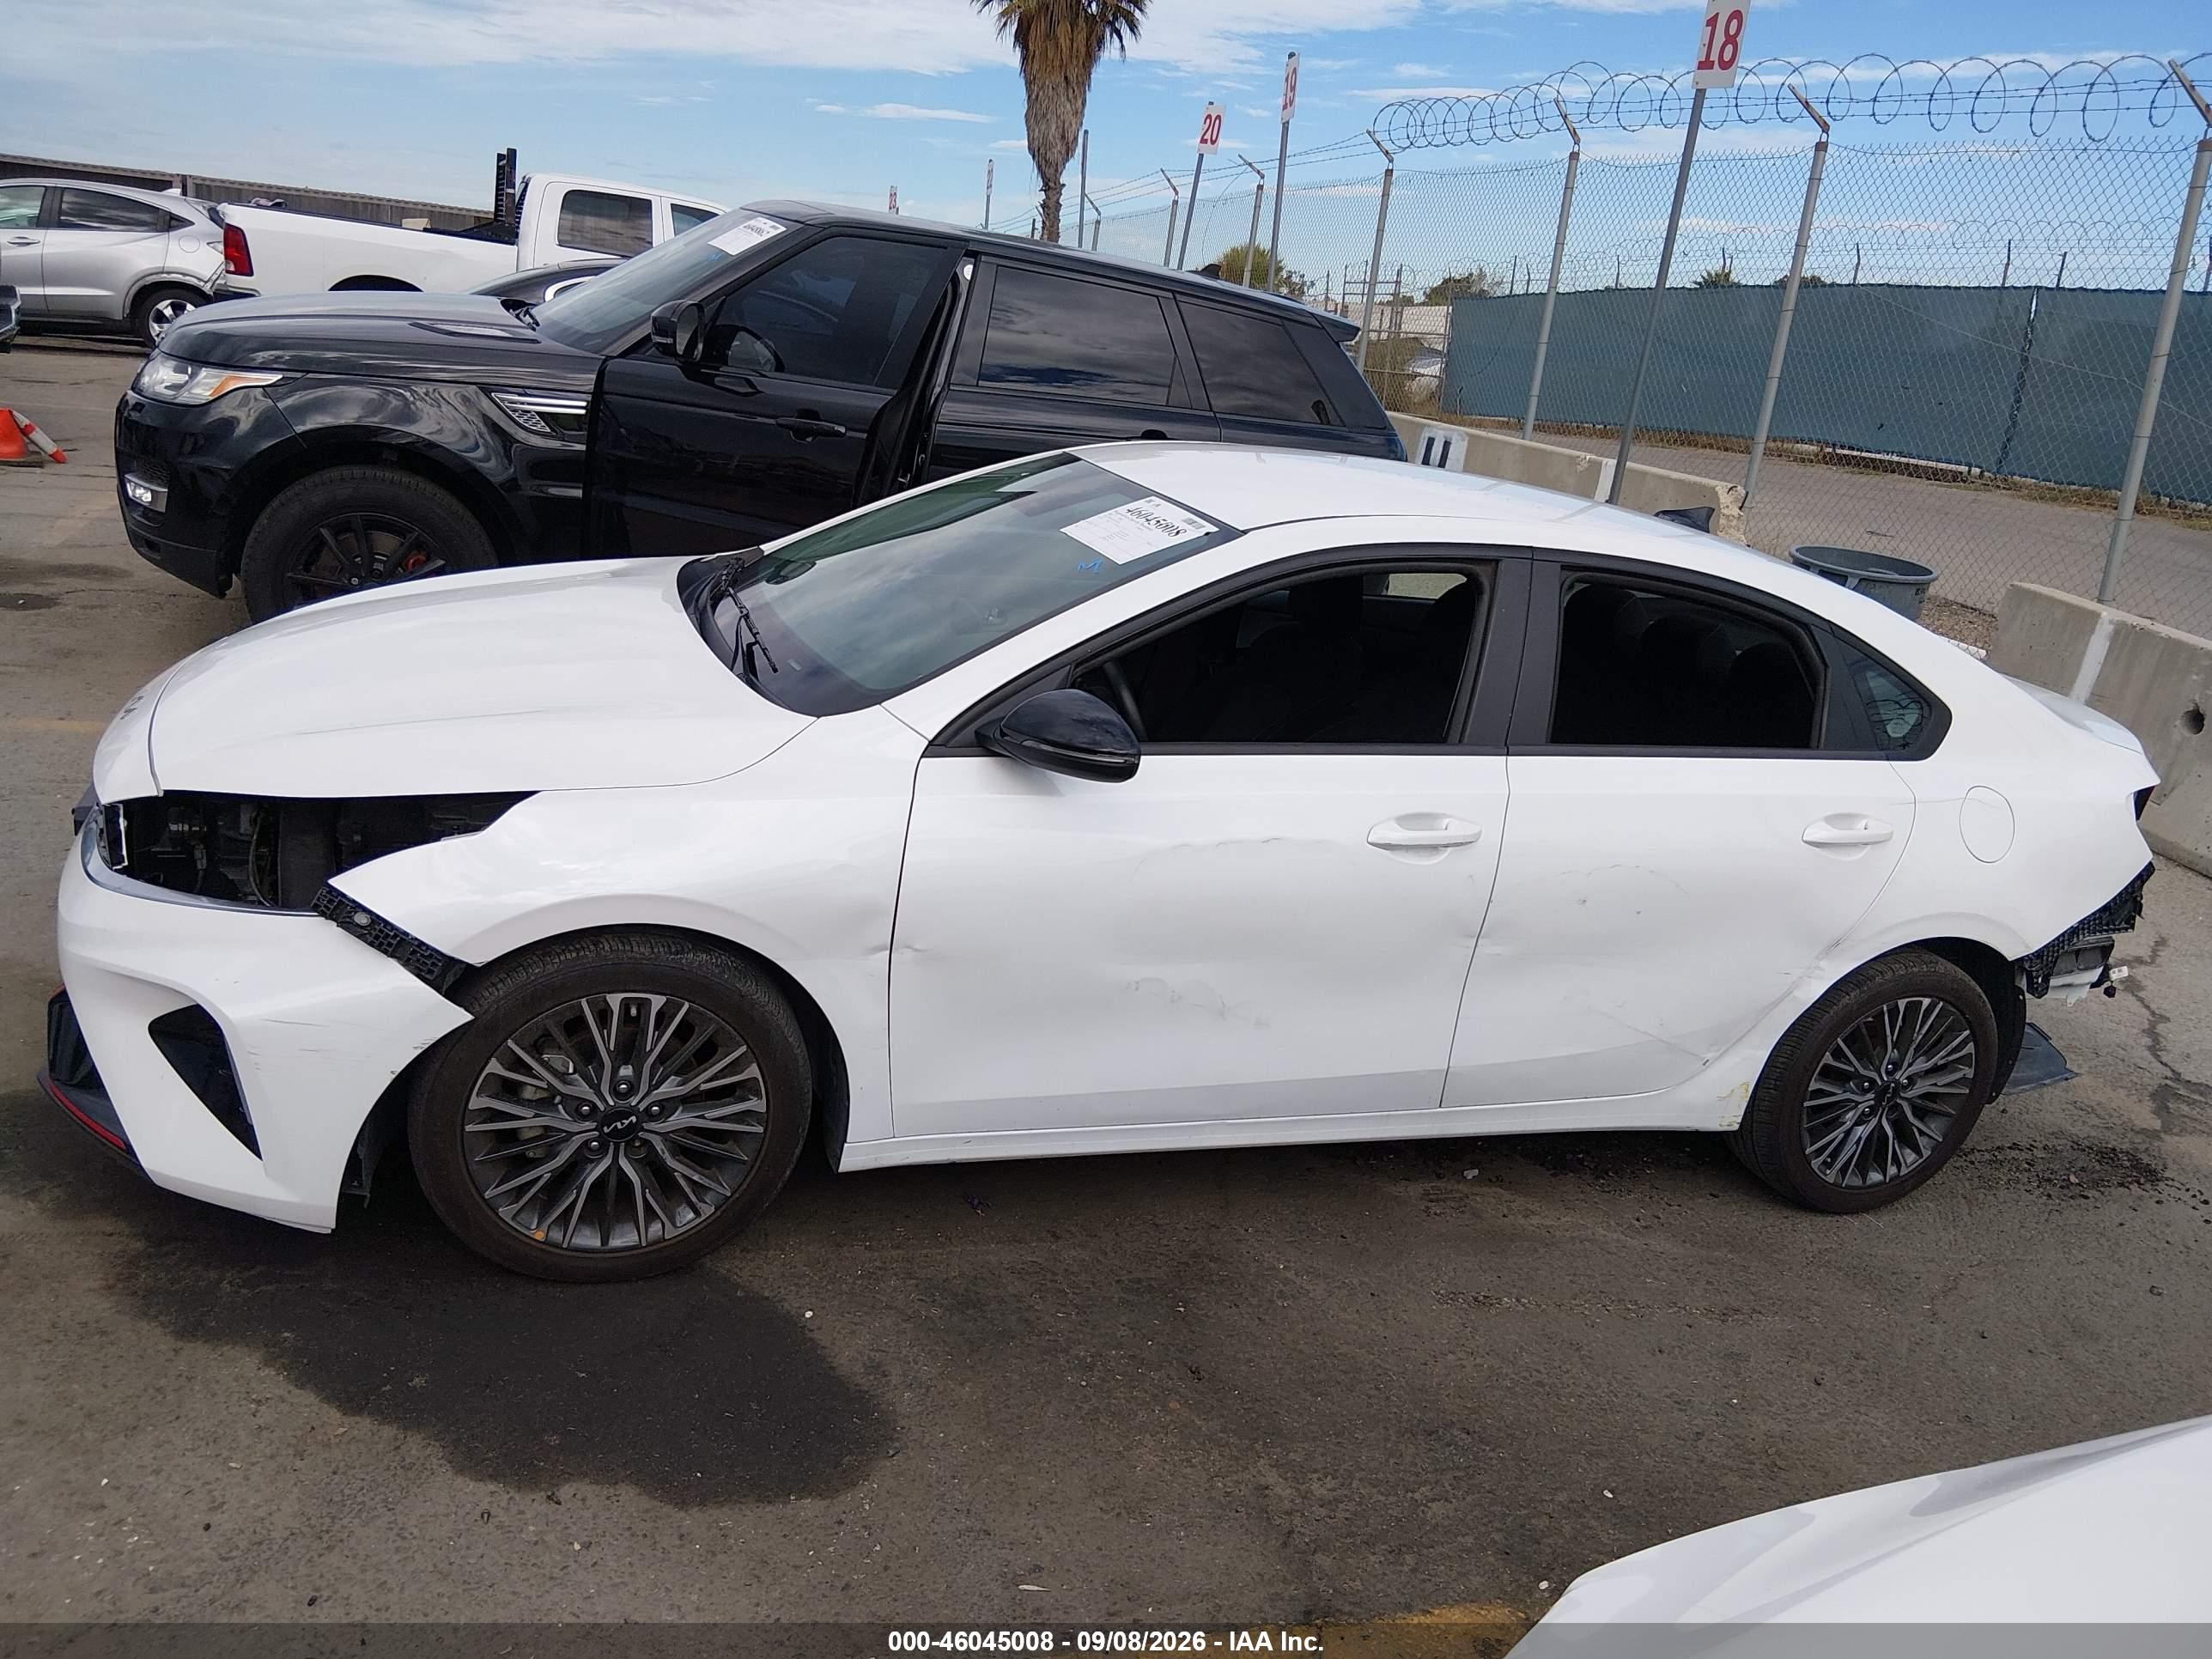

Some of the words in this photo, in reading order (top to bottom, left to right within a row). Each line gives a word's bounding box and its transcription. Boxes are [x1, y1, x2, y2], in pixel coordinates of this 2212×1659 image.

[1697, 9, 1744, 71] 18
[1282, 67, 1297, 111] 19
[1199, 113, 1222, 146] 20
[888, 191, 897, 210] 23
